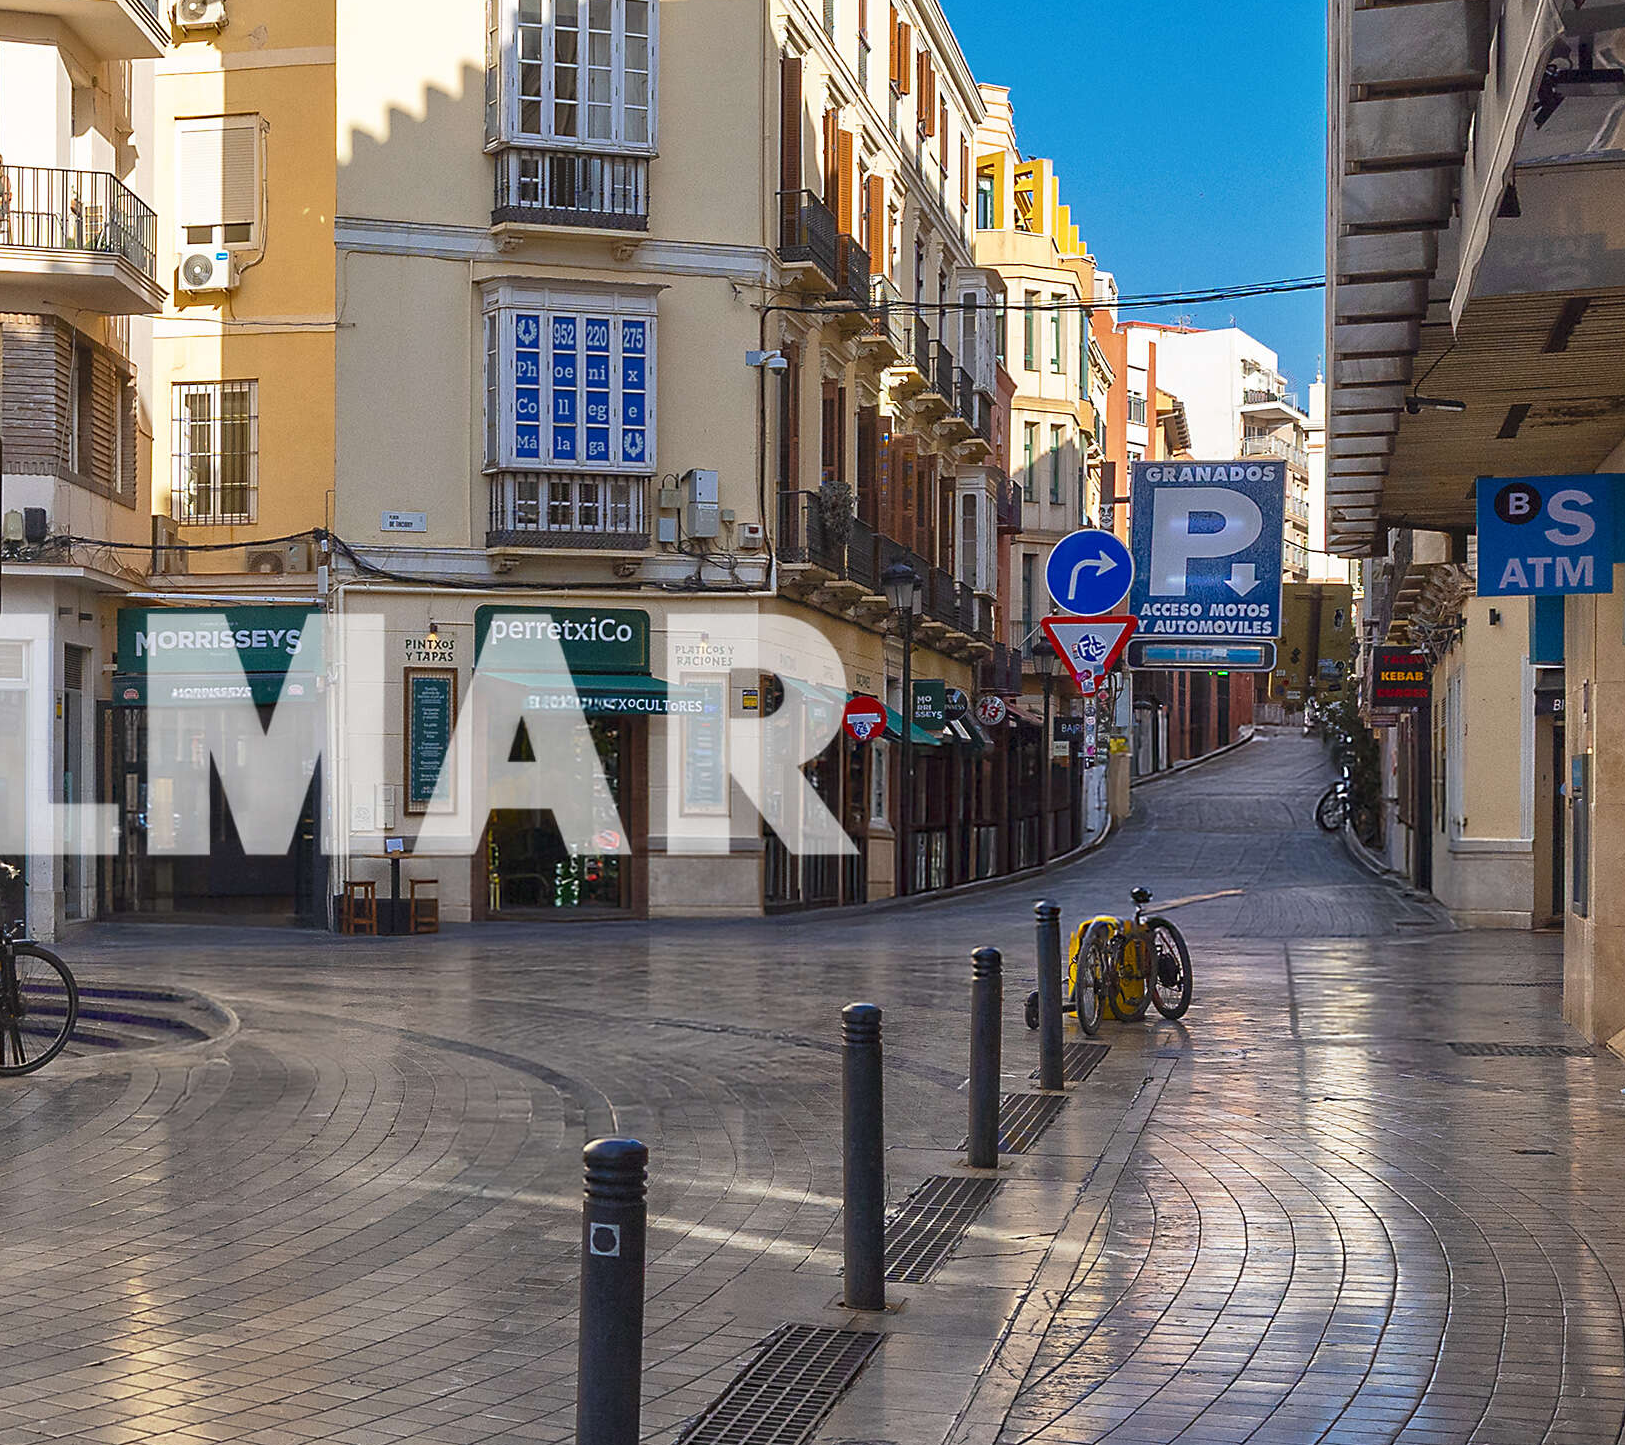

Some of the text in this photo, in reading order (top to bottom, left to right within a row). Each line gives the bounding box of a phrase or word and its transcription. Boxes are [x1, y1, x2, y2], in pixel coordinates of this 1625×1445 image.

[553, 323, 643, 349] 952 220 275
[1145, 466, 1276, 483] GRANADOS
[1509, 489, 1596, 546] B S
[1149, 487, 1263, 597] P
[1499, 555, 1594, 589] ATM
[1140, 603, 1270, 617] ACCESO MOTOS
[491, 617, 633, 643] perretxiCo
[1137, 619, 1272, 634] Y AUTOMOVILES
[136, 628, 303, 657] MORRISSEYS
[405, 652, 454, 663] Y TAPAS
[1381, 671, 1424, 681] KEBAB
